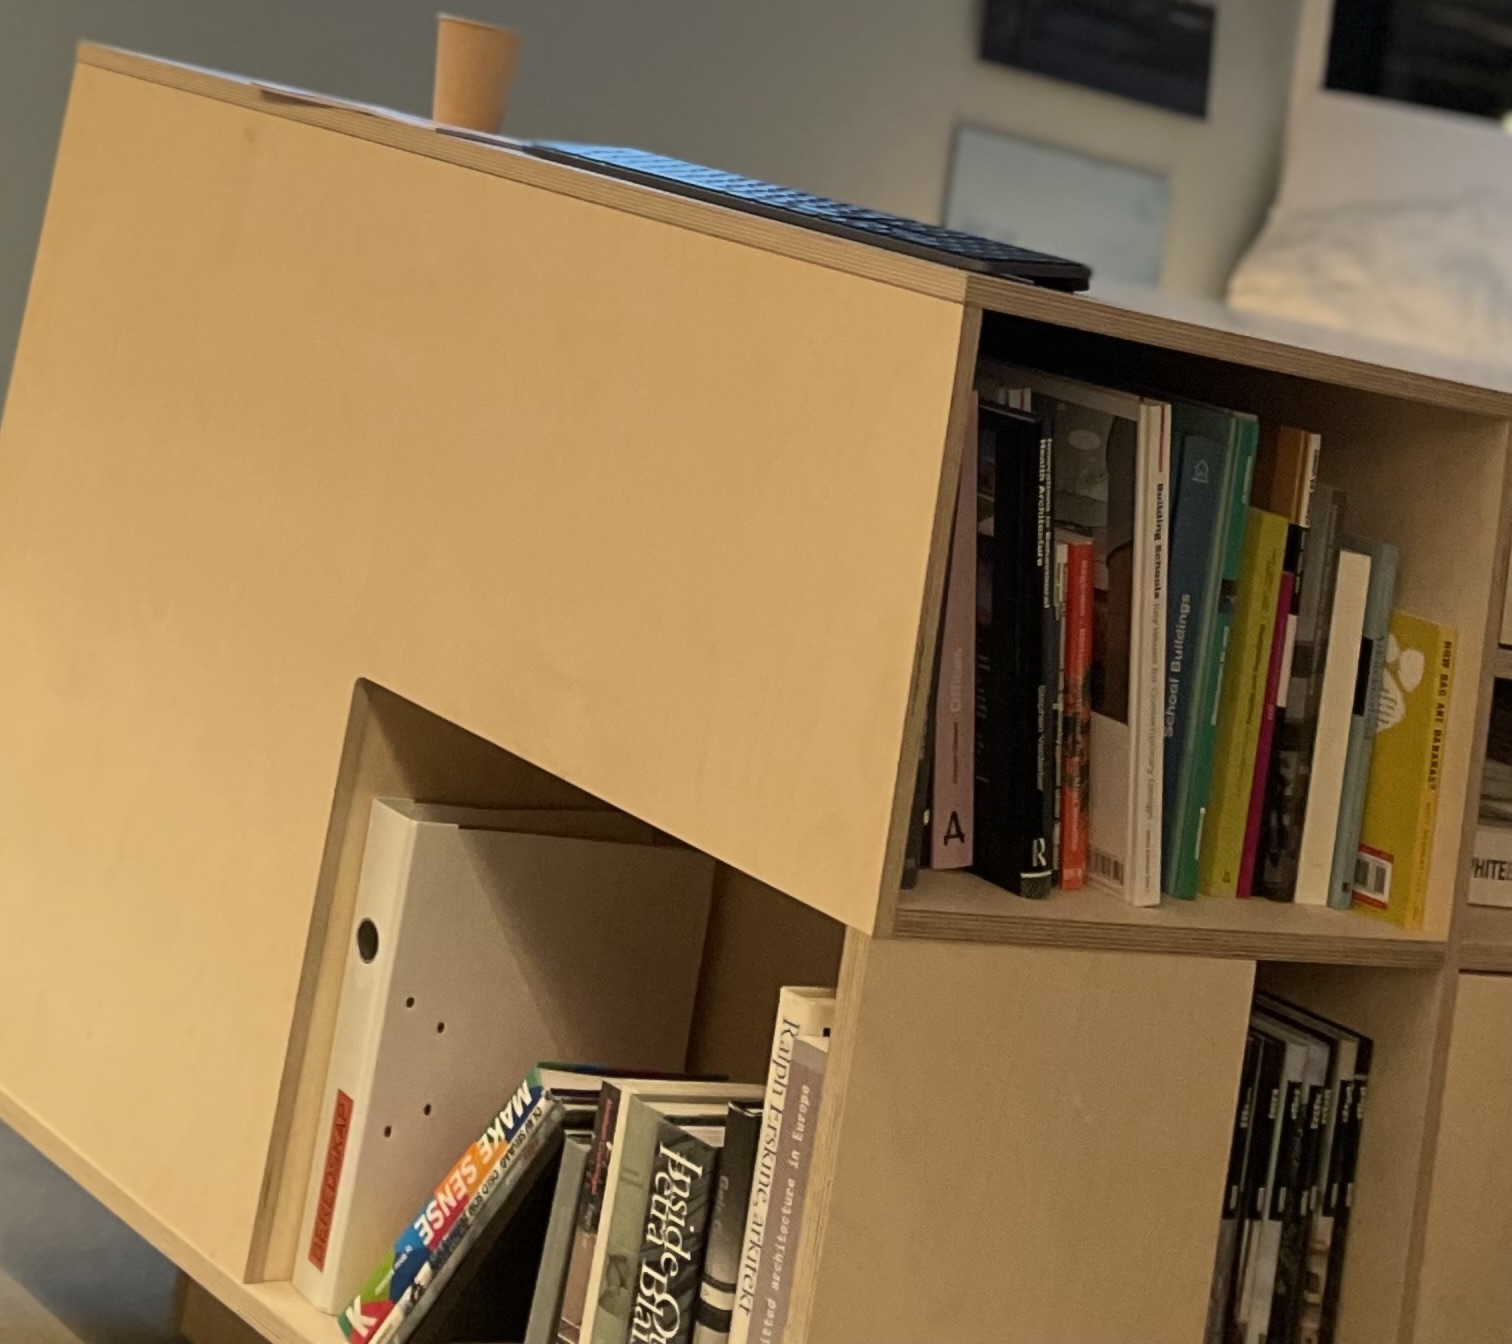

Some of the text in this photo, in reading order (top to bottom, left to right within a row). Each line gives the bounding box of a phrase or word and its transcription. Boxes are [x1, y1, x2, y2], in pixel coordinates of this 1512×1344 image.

[1037, 485, 1046, 567] Architecture
[1154, 483, 1164, 542] Building
[1153, 543, 1163, 600] Schools
[1164, 593, 1191, 739] School Buildings
[1441, 640, 1453, 669] HOW
[1438, 673, 1450, 697] BAD
[772, 1017, 800, 1096] Ralph
[792, 1084, 811, 1143] Europe
[414, 1079, 533, 1246] MAKE SENSE
[788, 1150, 801, 1169] in
[659, 1141, 703, 1277] Inside
[771, 1178, 796, 1291] architecture
[345, 1295, 378, 1338] K
